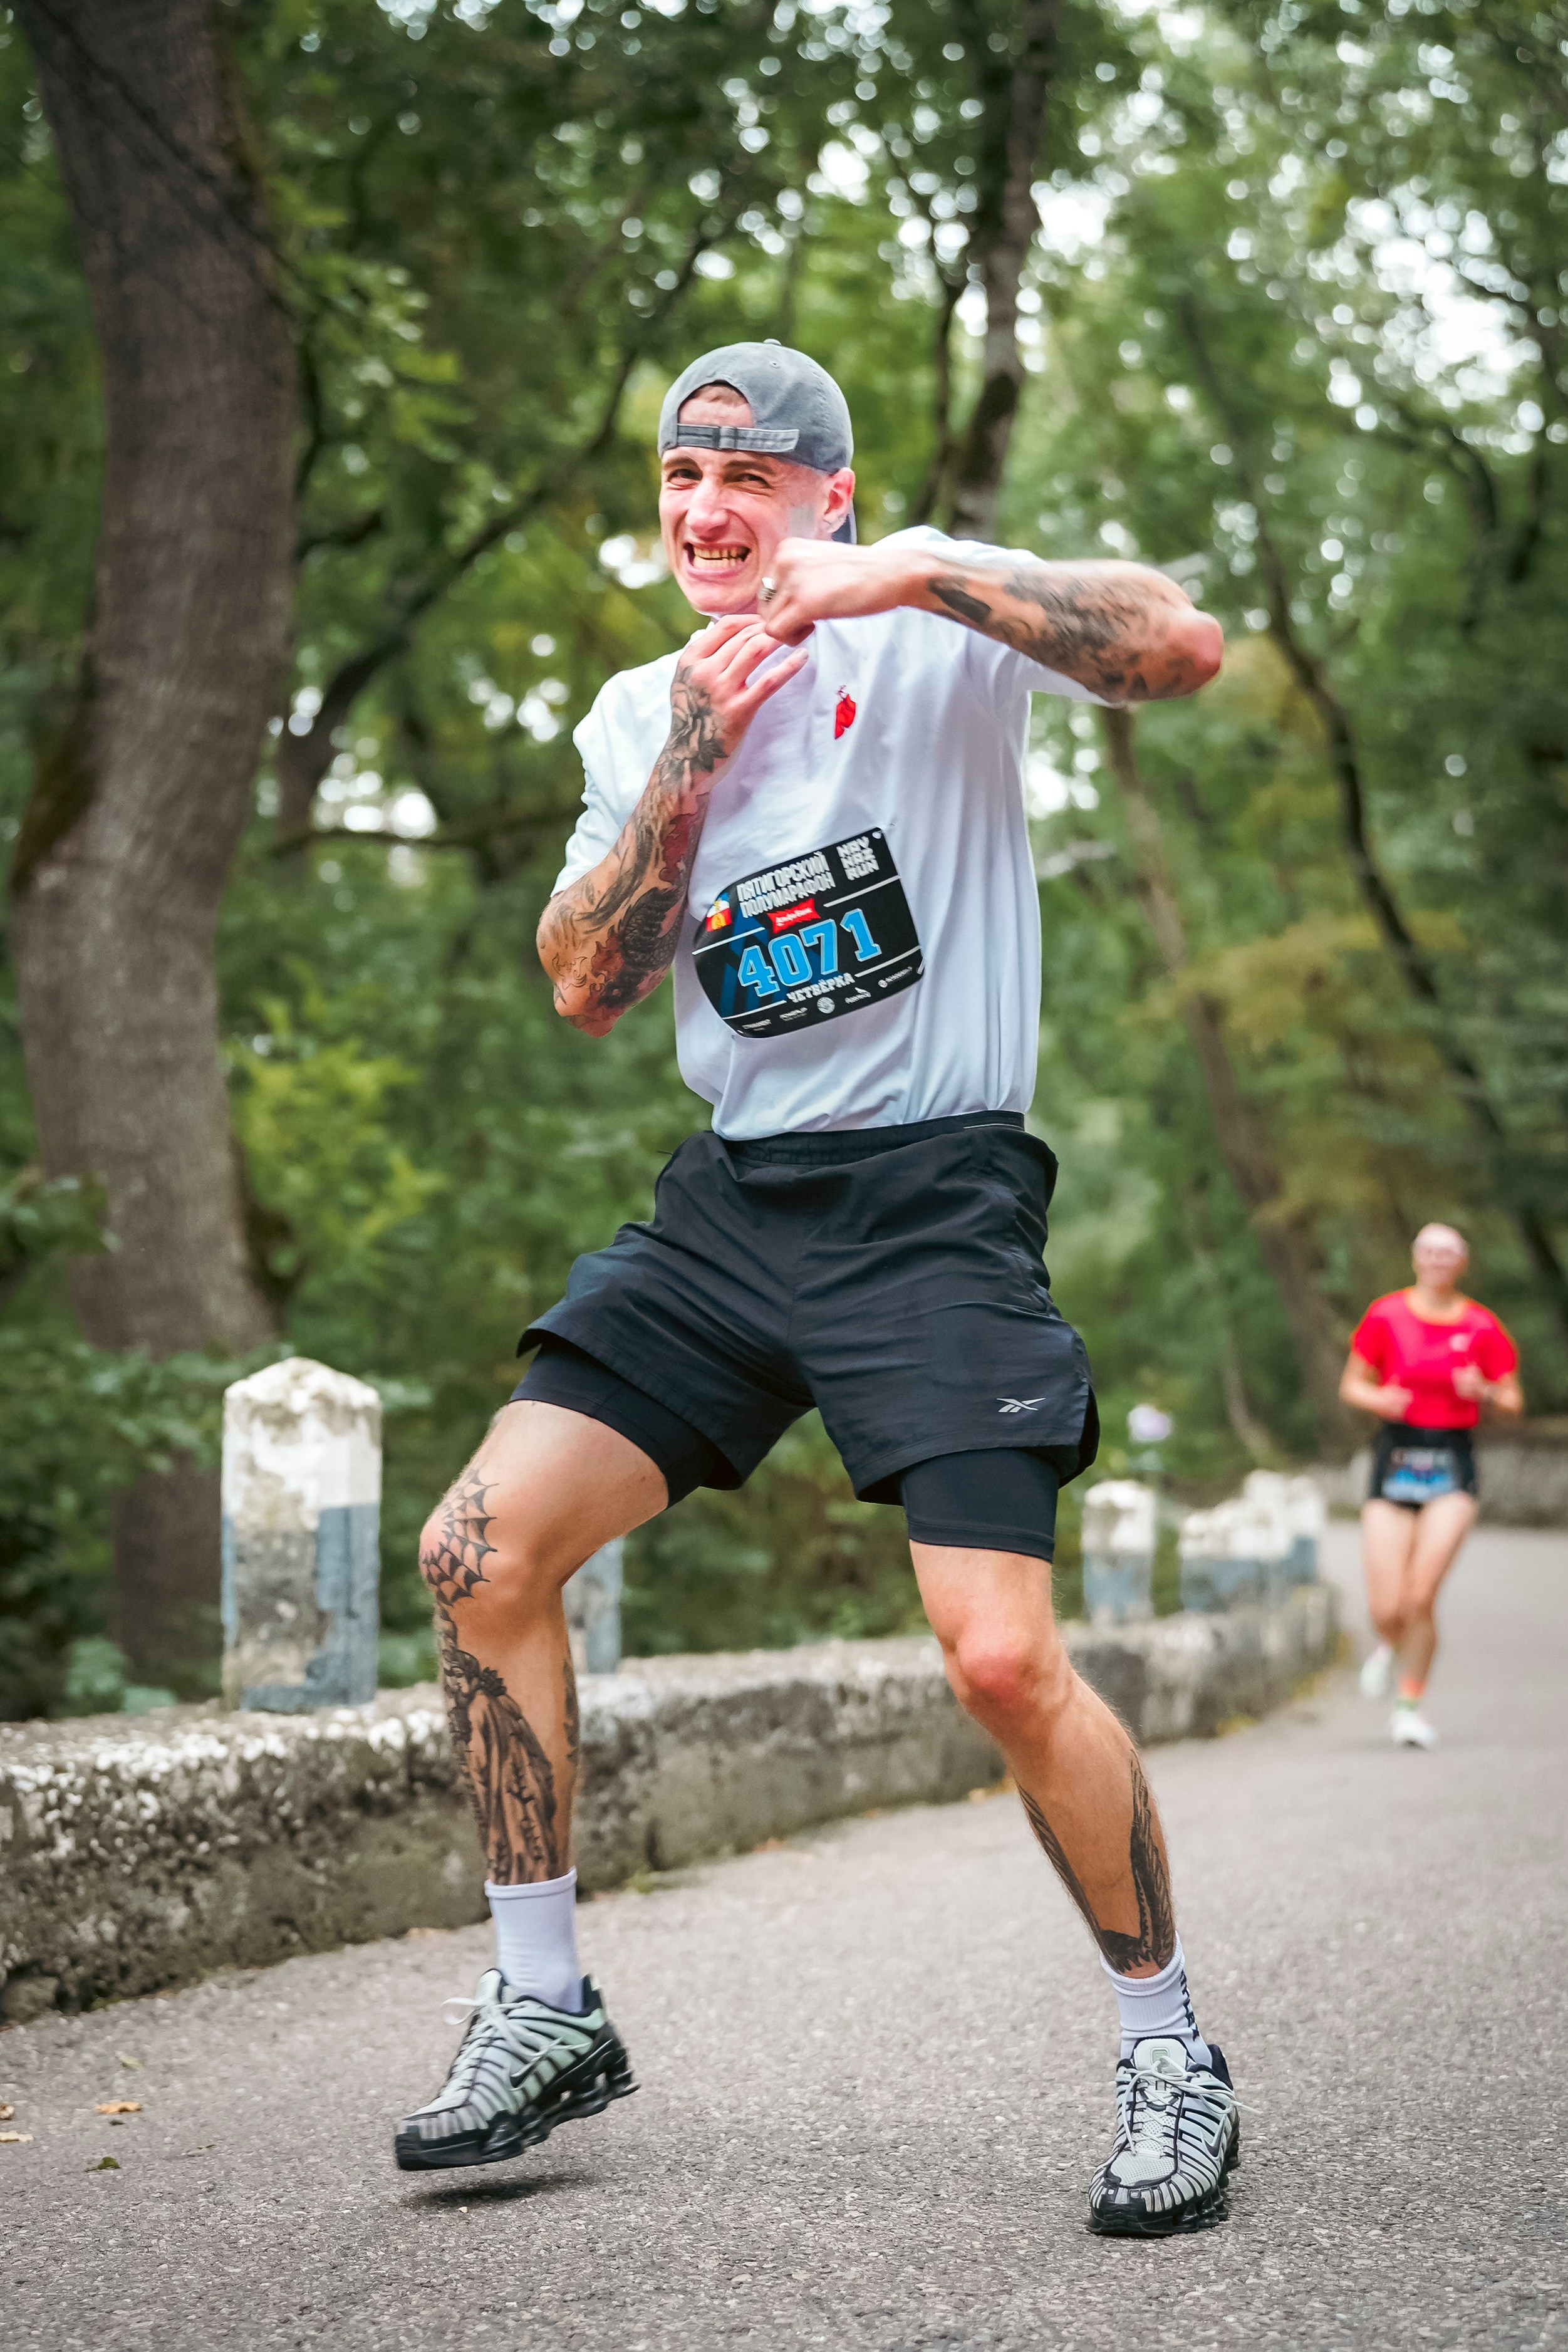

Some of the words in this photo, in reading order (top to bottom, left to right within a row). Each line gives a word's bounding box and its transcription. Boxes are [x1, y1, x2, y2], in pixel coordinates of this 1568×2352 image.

[736, 851, 831, 902] ПЯТИГОРСКИЙ
[844, 859, 880, 881] RUN
[739, 872, 836, 918] ПОЛУМАРАФОН
[737, 908, 882, 997] 4071
[786, 972, 856, 1003] ЧЕТВЁРКА
